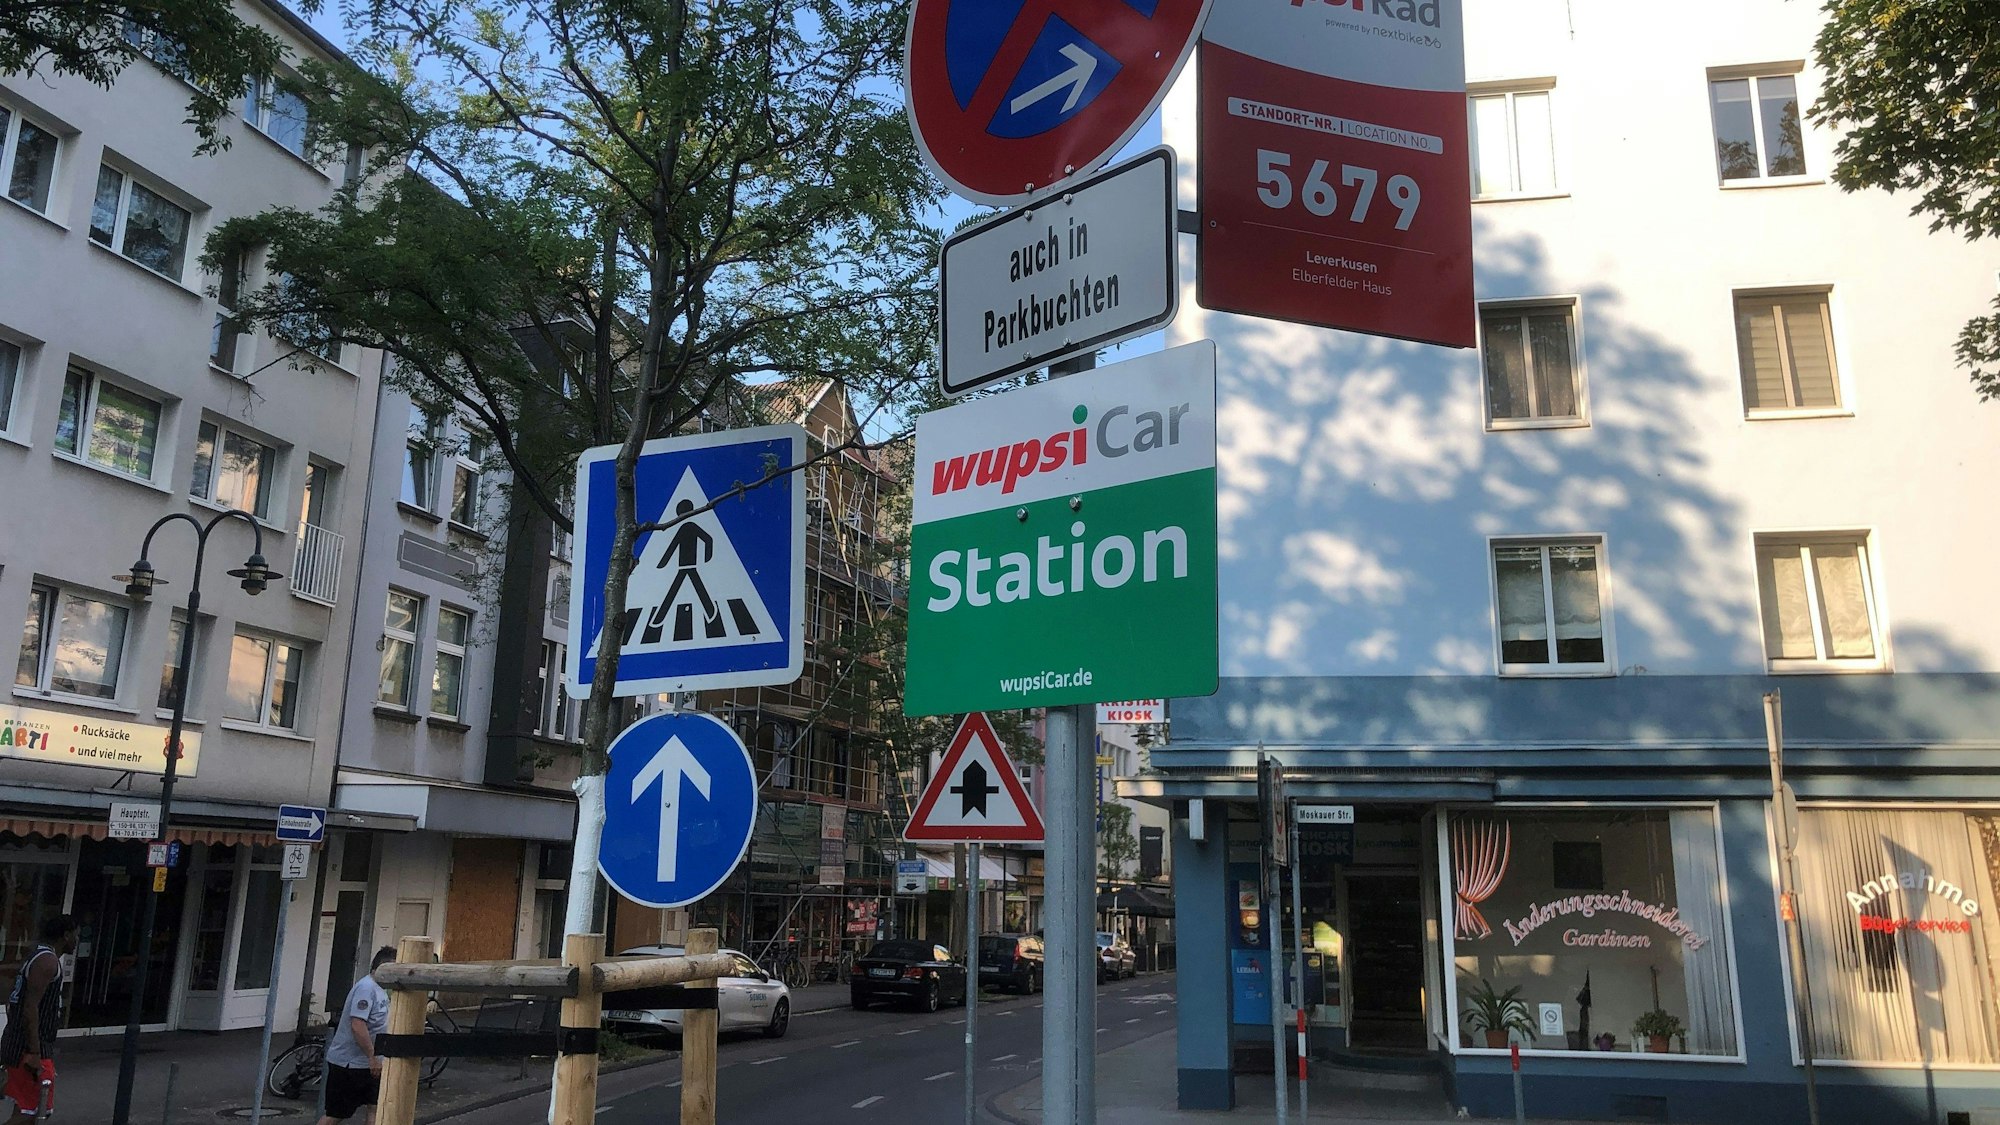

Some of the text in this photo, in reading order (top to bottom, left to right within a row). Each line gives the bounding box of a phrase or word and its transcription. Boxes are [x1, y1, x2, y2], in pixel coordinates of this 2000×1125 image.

[1325, 18, 1423, 45] powered by nextbike
[1241, 102, 1431, 150] STANDORT-NR. LOCATION NO.
[1256, 149, 1421, 231] 5679
[1010, 217, 1088, 283] auch in
[1306, 250, 1378, 274] Leverkusen
[1292, 268, 1392, 296] Elberfelder Haus
[984, 273, 1119, 353] Parkbuchten
[927, 521, 1188, 612] Station
[1000, 668, 1093, 695] wupsiCar.de
[17, 721, 51, 730] RANZEN
[1107, 710, 1152, 721] KIOSK
[81, 724, 131, 741] Rucksäcke
[78, 747, 143, 763] und viel mehr
[120, 808, 150, 820] Hauptstr.
[1300, 809, 1352, 820] Moskauer Str.
[1846, 868, 1979, 917] Annahme
[1503, 889, 1709, 951] Änderungsschneiderei
[1563, 929, 1651, 948] Gardinen
